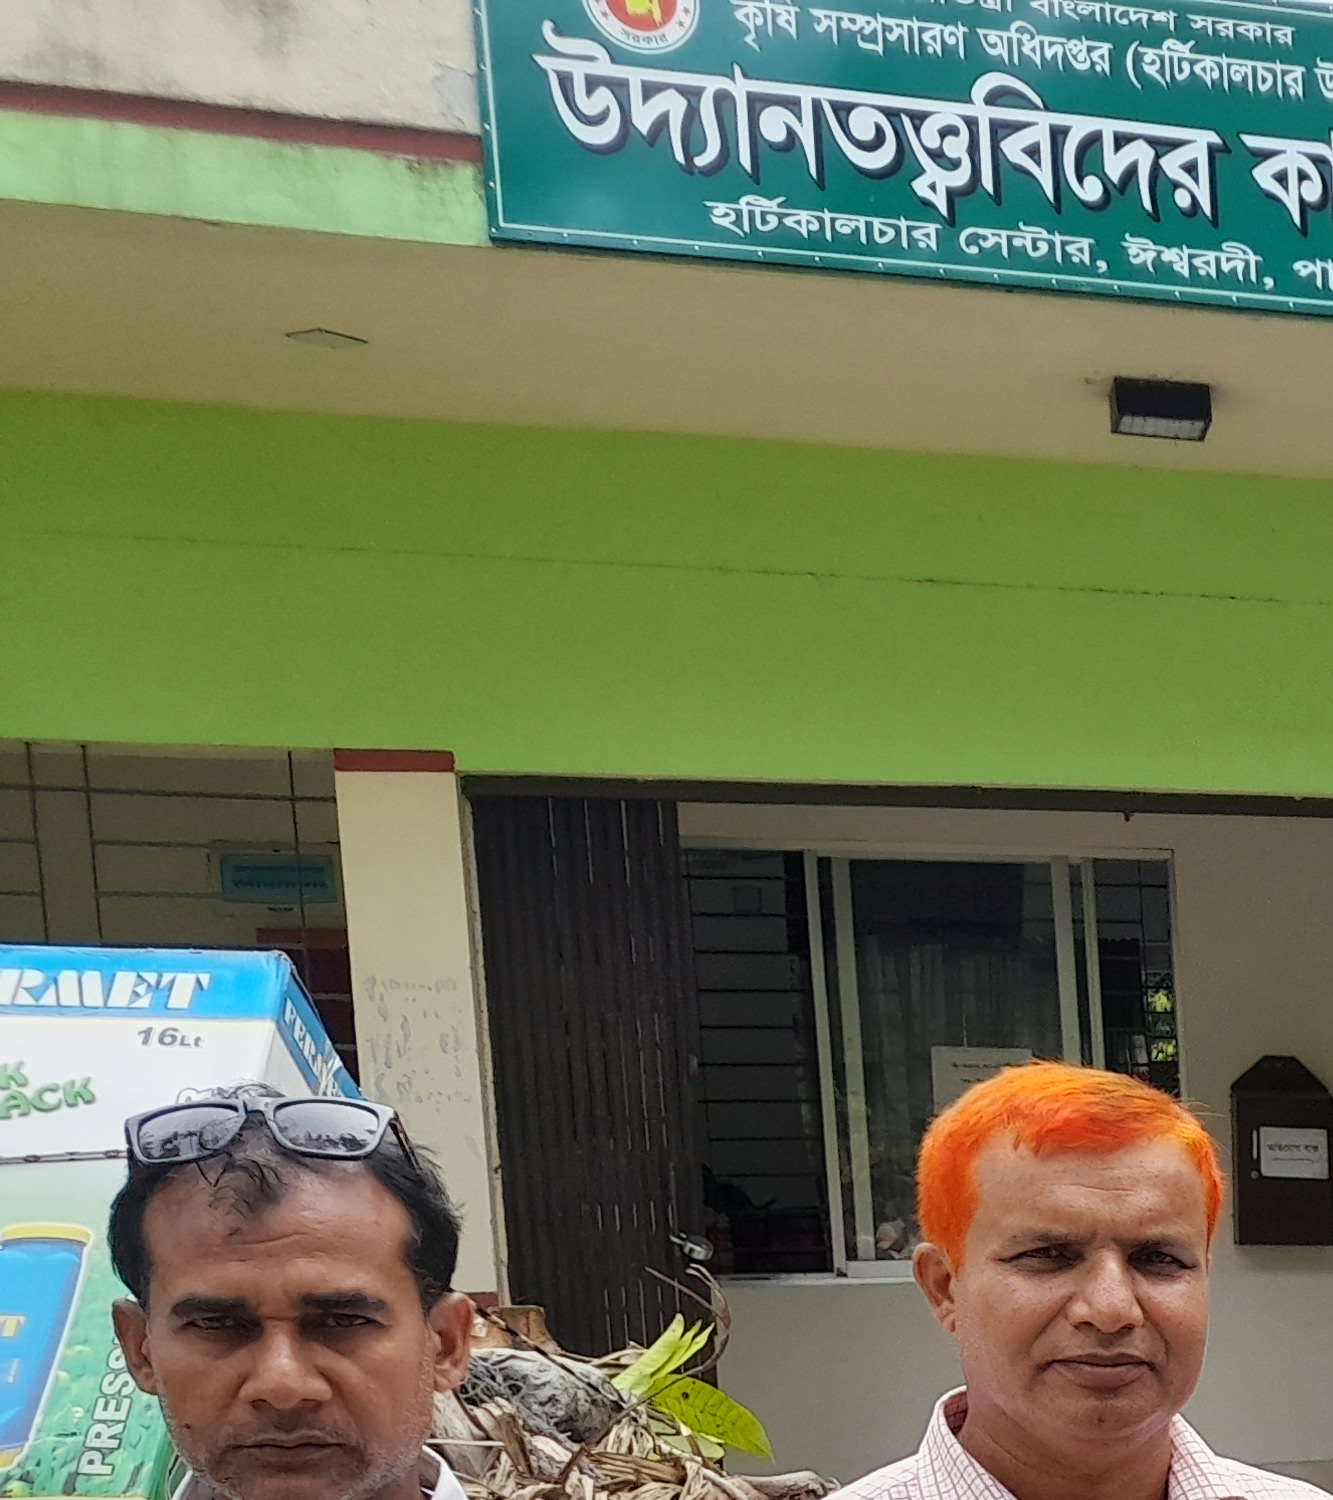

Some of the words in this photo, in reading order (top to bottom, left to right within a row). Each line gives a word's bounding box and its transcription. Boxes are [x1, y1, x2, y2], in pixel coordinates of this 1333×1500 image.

[813, 7, 967, 60] সম্প্রসারণ
[982, 20, 1112, 76] অধিদপ্তর
[1188, 13, 1295, 47] সরকার
[704, 194, 940, 252] হর্টিকালচার
[959, 222, 1108, 274] সেন্টার,
[1122, 233, 1276, 290] ঈশ্বরদী,
